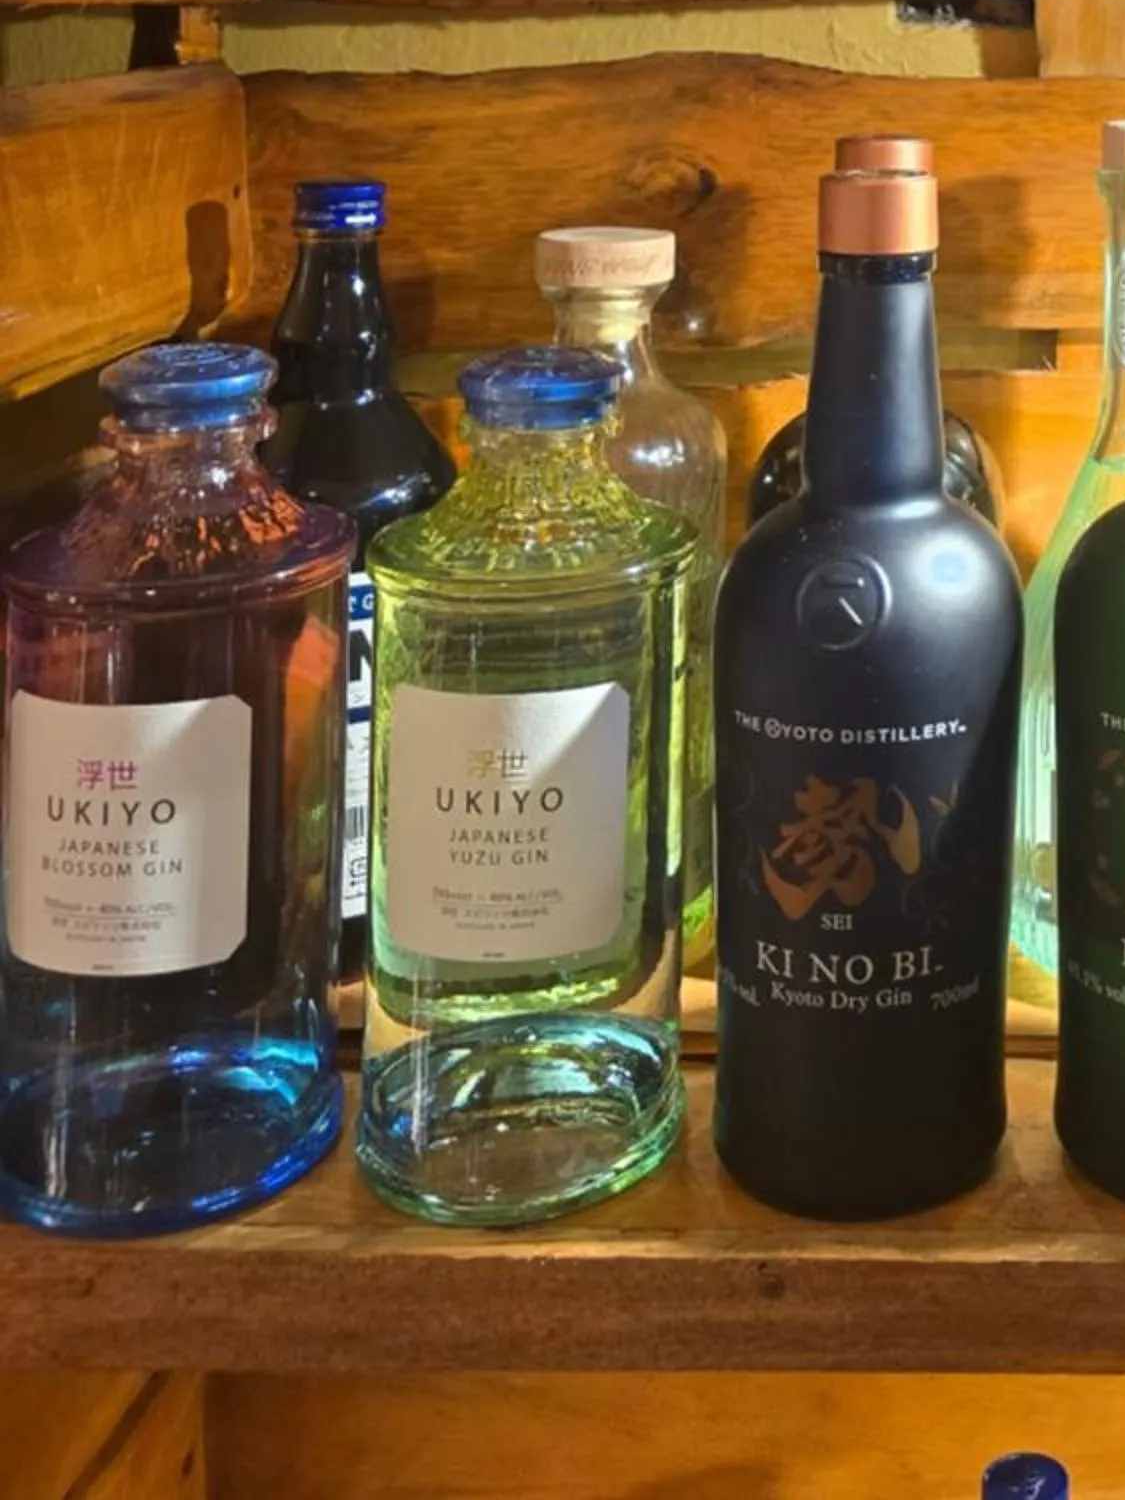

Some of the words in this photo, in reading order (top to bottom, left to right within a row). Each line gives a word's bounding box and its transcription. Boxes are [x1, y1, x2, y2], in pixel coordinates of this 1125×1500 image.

[734, 709, 760, 733] THE
[47, 794, 177, 827] UKIYO
[435, 786, 564, 816] UKIYO
[449, 826, 551, 845] JAPANESE
[58, 837, 161, 857] JAPANESE
[449, 849, 501, 866] YUZU
[511, 849, 549, 866] GIN
[41, 857, 132, 878] BLOSSOM
[143, 858, 184, 876] GIN
[819, 913, 854, 932] SEI
[755, 939, 796, 980] KI
[808, 953, 875, 986] NO
[770, 980, 825, 1009] Kyoto
[829, 990, 870, 1013] Dry
[875, 986, 914, 1008] Gin
